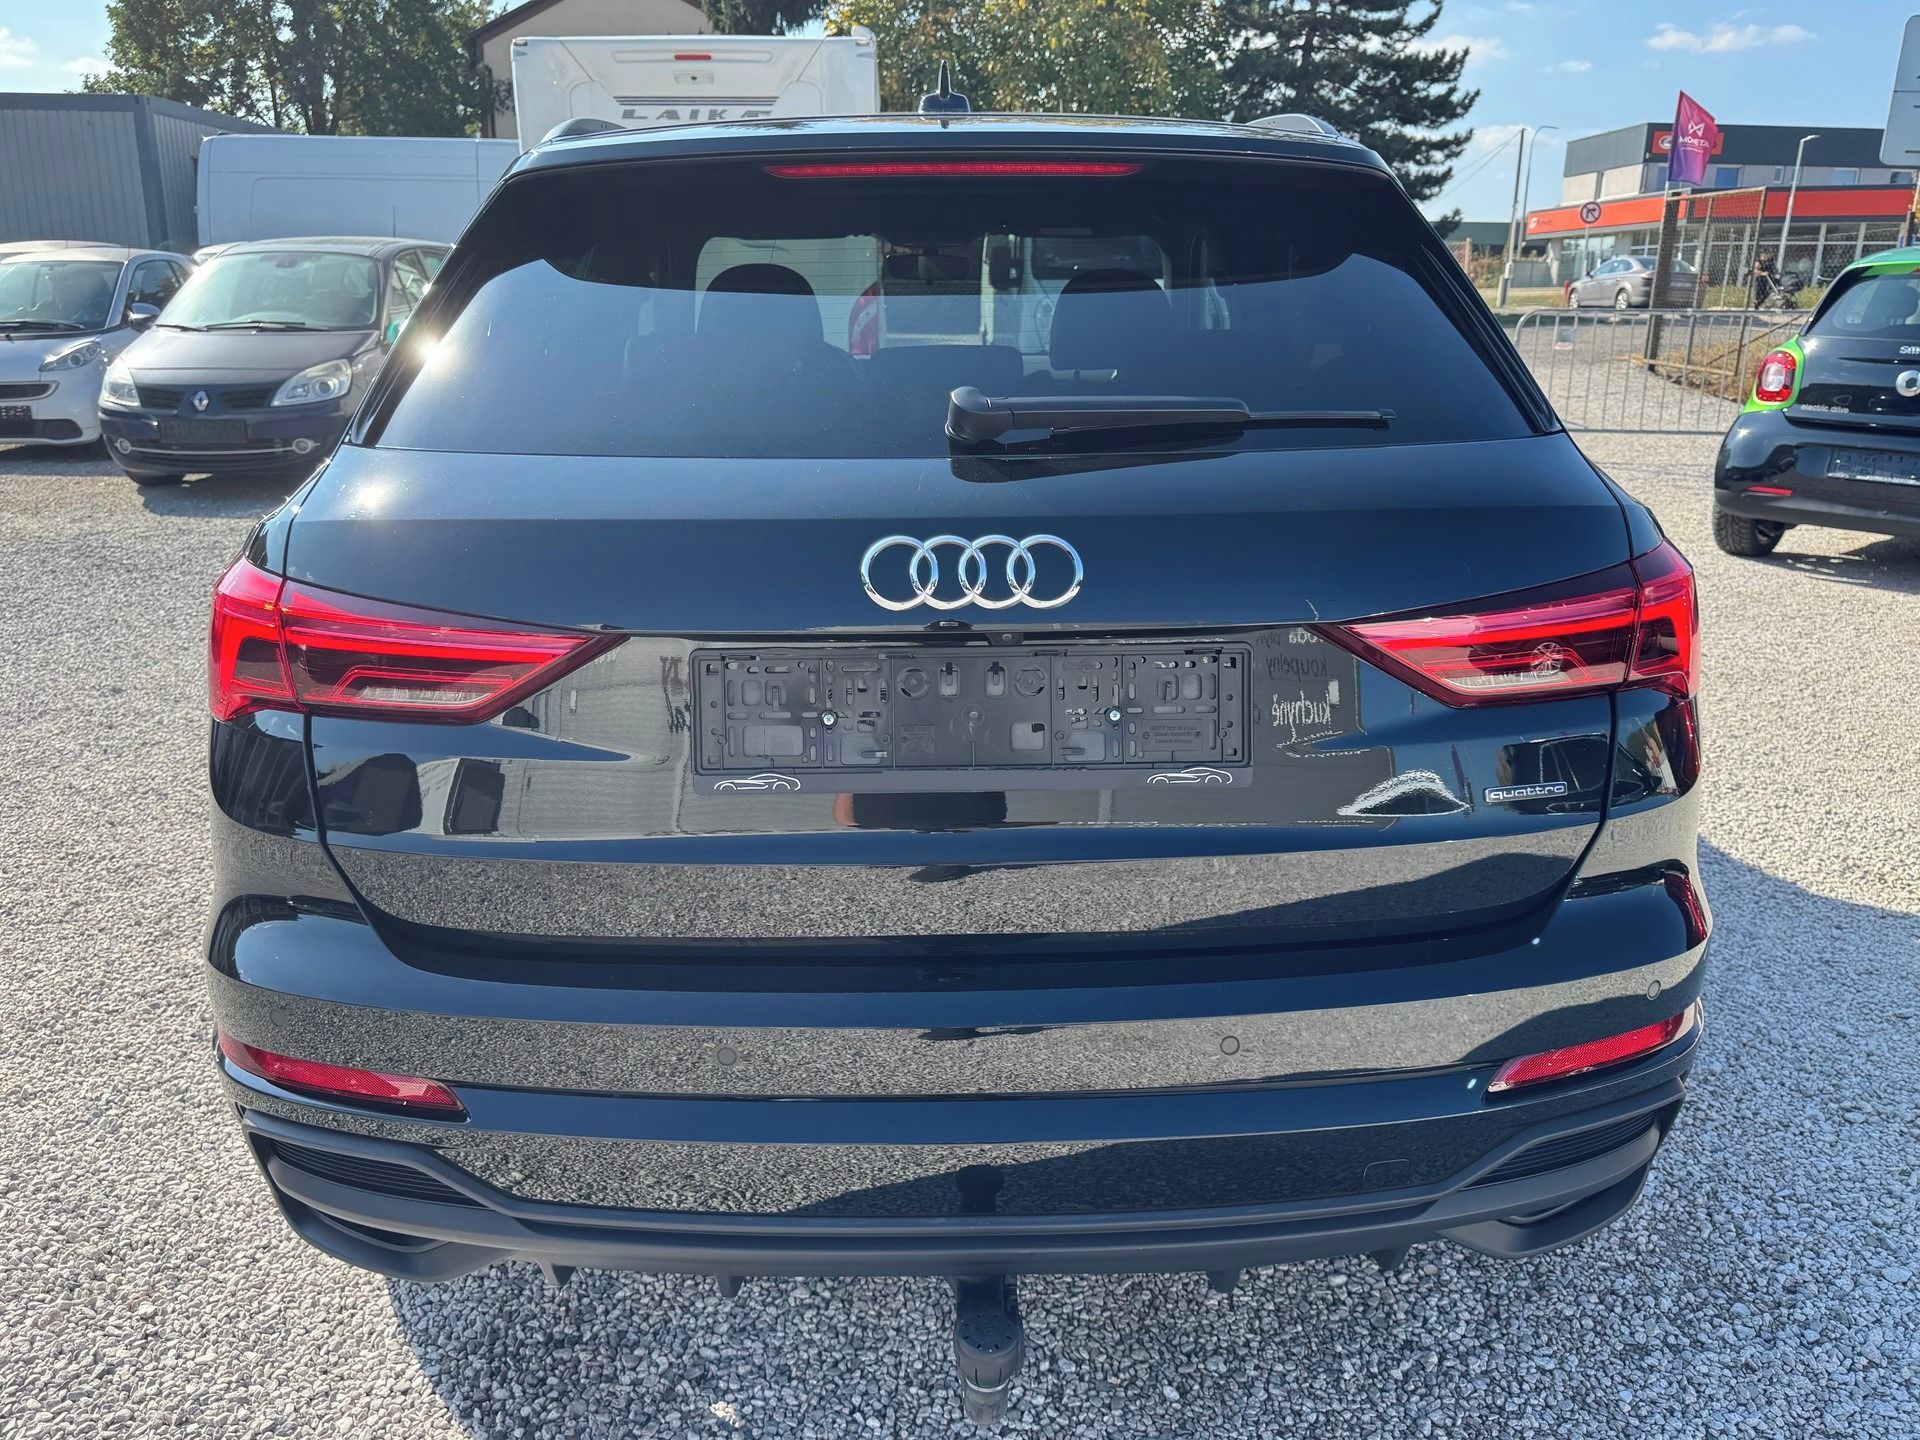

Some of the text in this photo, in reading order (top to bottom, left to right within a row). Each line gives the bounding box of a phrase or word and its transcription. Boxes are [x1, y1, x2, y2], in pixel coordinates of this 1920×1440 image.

[621, 109, 774, 121] LAIKA
[1800, 404, 1850, 414] electric drive
[1490, 785, 1565, 799] quattro
